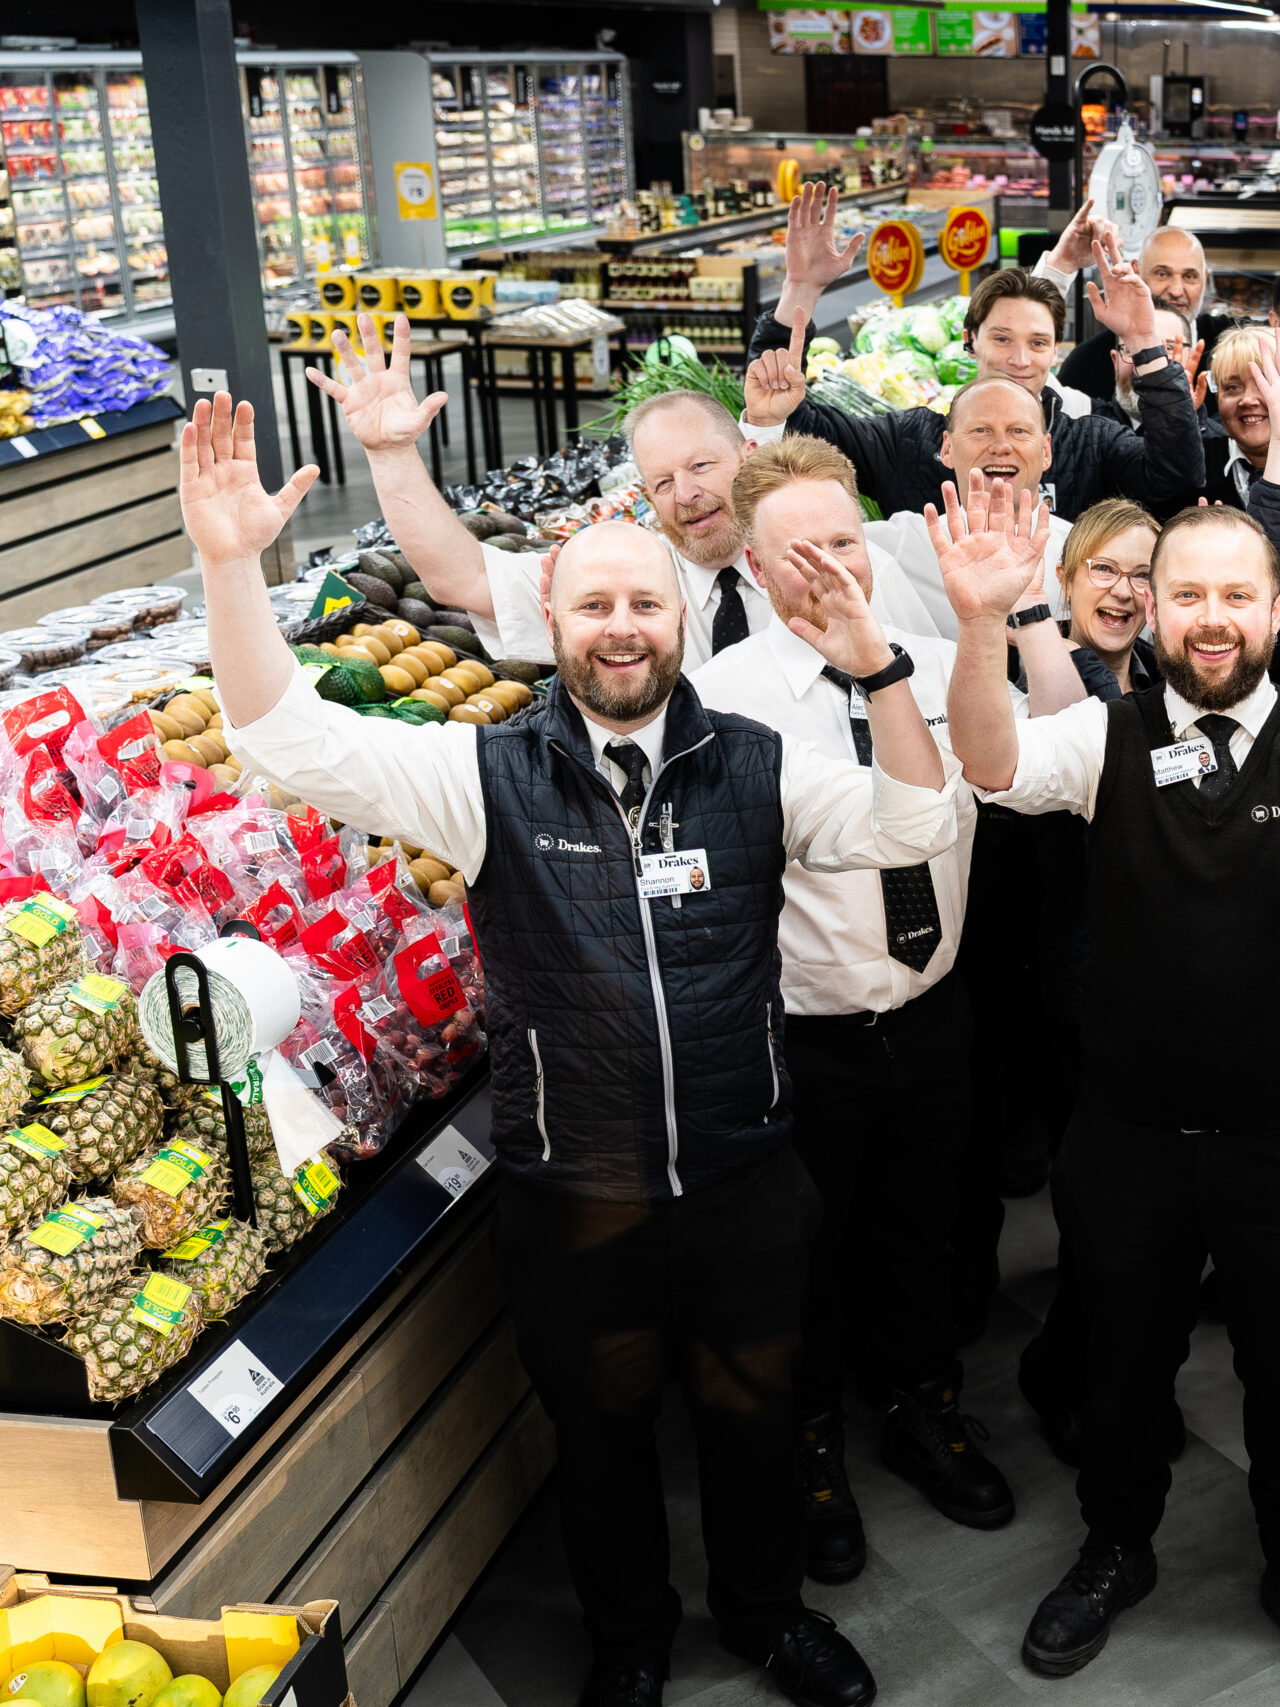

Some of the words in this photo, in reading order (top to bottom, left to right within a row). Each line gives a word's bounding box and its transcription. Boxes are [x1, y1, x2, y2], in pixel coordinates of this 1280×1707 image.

[1154, 763, 1183, 777] Matthew
[557, 838, 602, 853] Drakes.
[639, 876, 675, 887] Shannon
[33, 909, 59, 926] GOLD
[434, 986, 456, 1005] RED
[168, 1155, 195, 1173] GOLD
[58, 1218, 87, 1233] GOLD
[143, 1299, 172, 1318] GOLD
[260, 1380, 276, 1397] Australia
